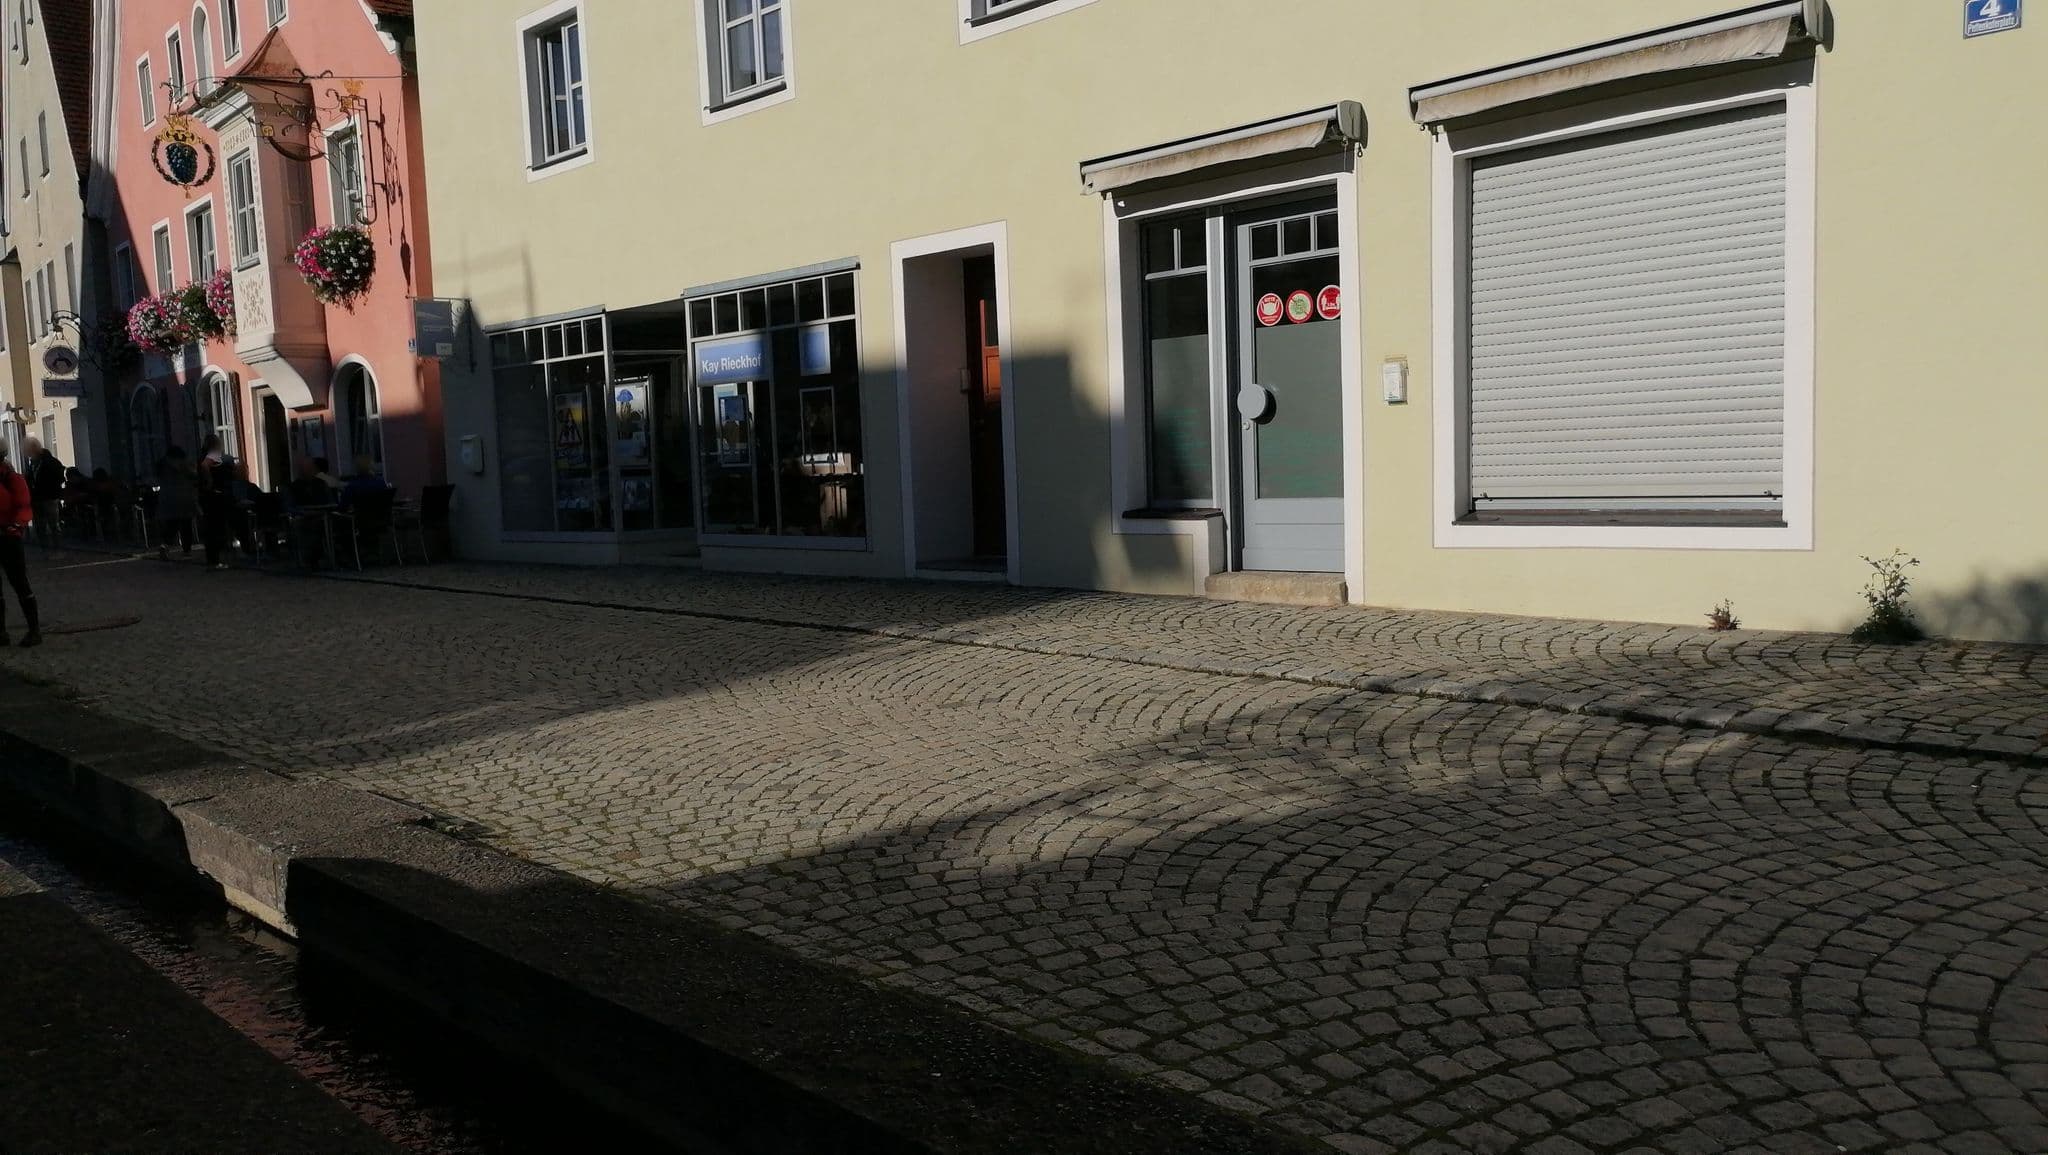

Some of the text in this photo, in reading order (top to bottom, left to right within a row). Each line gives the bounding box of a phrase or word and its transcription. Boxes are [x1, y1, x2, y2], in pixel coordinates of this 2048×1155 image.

[1979, 0, 2000, 17] 4
[702, 354, 761, 375] Kay Rieckhof
